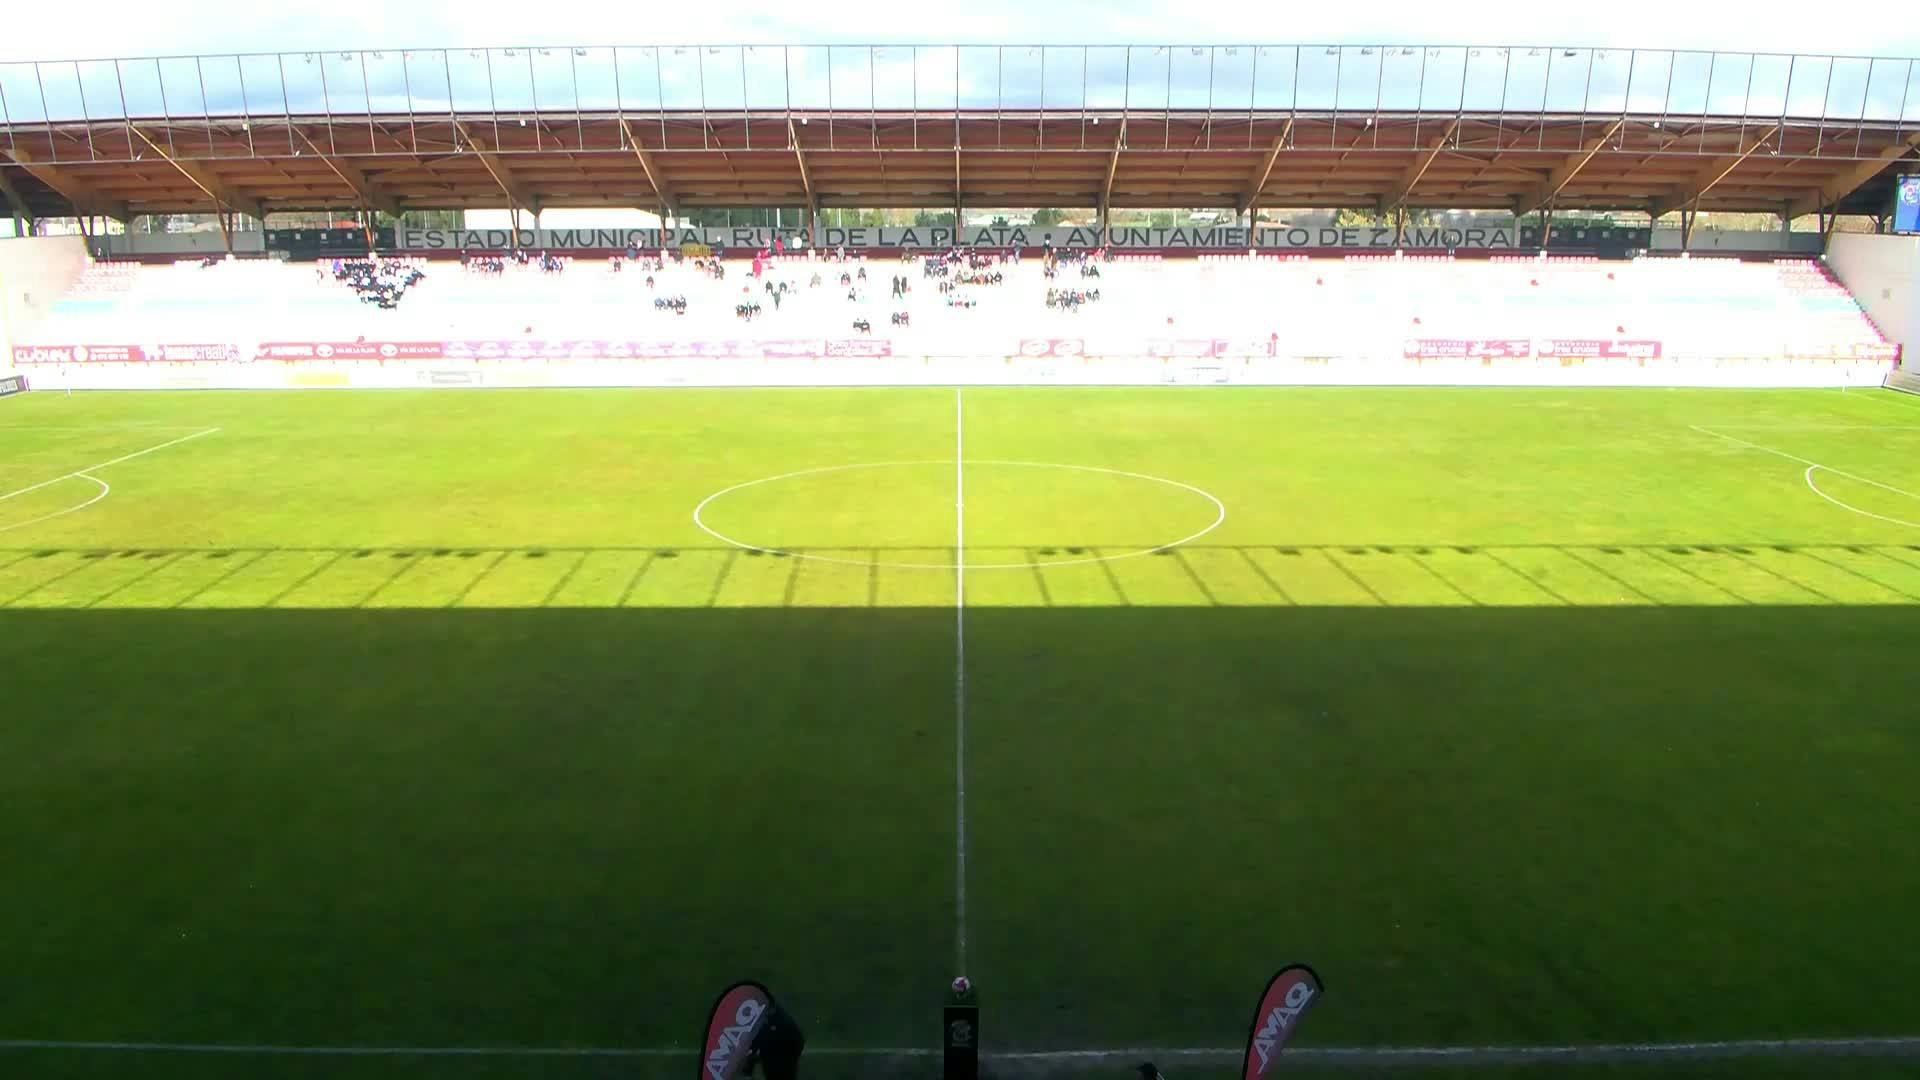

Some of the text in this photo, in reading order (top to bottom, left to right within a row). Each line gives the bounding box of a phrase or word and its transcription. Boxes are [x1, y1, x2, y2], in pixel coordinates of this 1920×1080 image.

[405, 228, 1510, 248] ESTADIO MUNICIPAL RUTA DE LA PLATA AYUNTAMIENTO DE ZAMORA
[1254, 981, 1315, 1075] AMAQ
